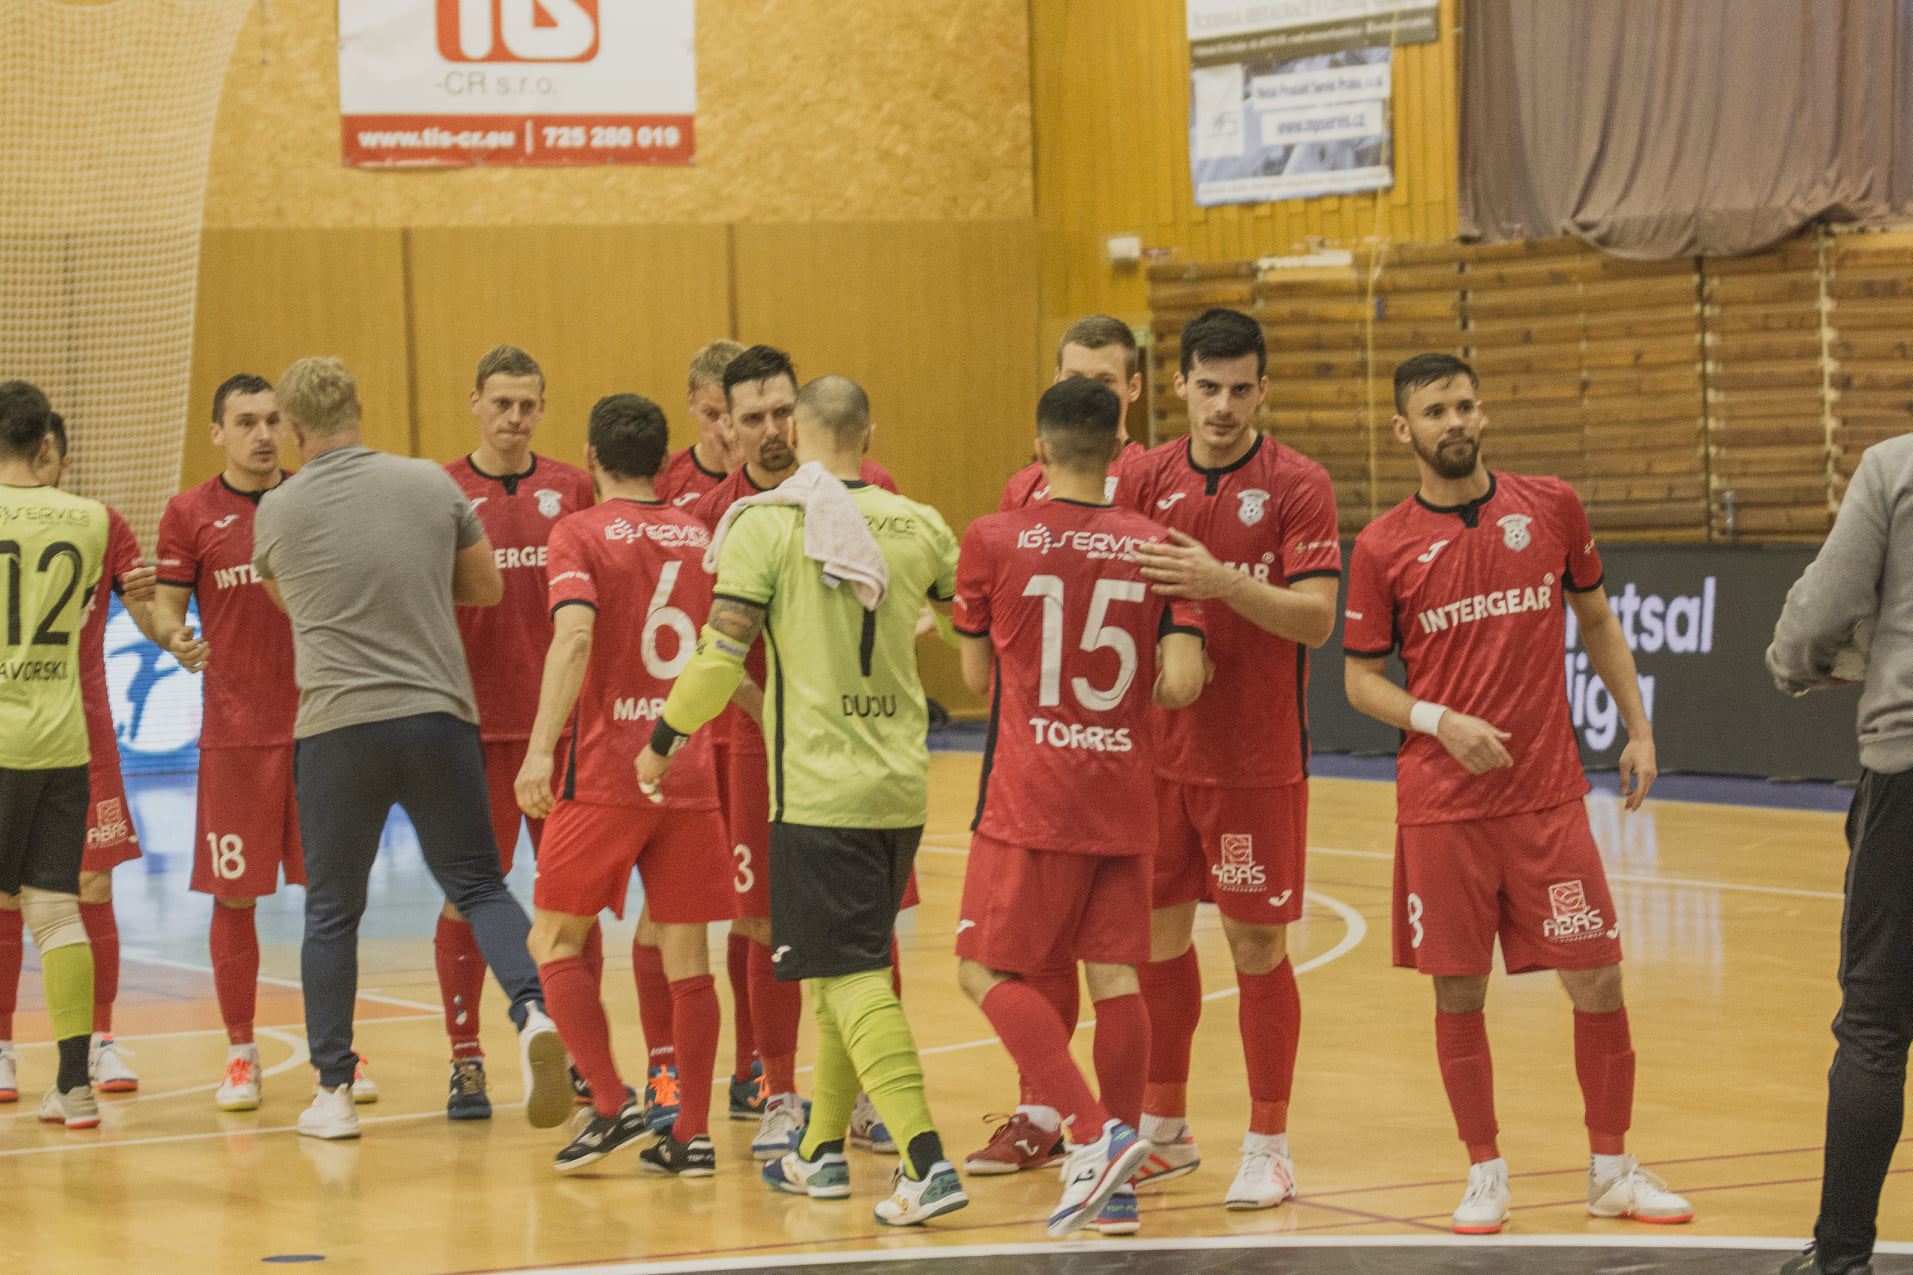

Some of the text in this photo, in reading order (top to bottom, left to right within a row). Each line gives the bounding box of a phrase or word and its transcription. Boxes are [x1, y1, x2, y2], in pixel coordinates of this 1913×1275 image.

[496, 75, 558, 96] s.r.o.
[358, 126, 680, 148] www.tis-cr.eu 725 280 019
[1052, 530, 1158, 553] SERVIC
[0, 540, 82, 646] 12
[1417, 585, 1552, 635] INTERGEAR
[641, 561, 698, 680] 6
[1022, 574, 1147, 712] 15
[842, 694, 896, 717] DUDU
[1029, 717, 1133, 752] TORRES
[207, 832, 246, 879] 18
[733, 843, 755, 893] 3
[1543, 909, 1603, 937] ABAS
